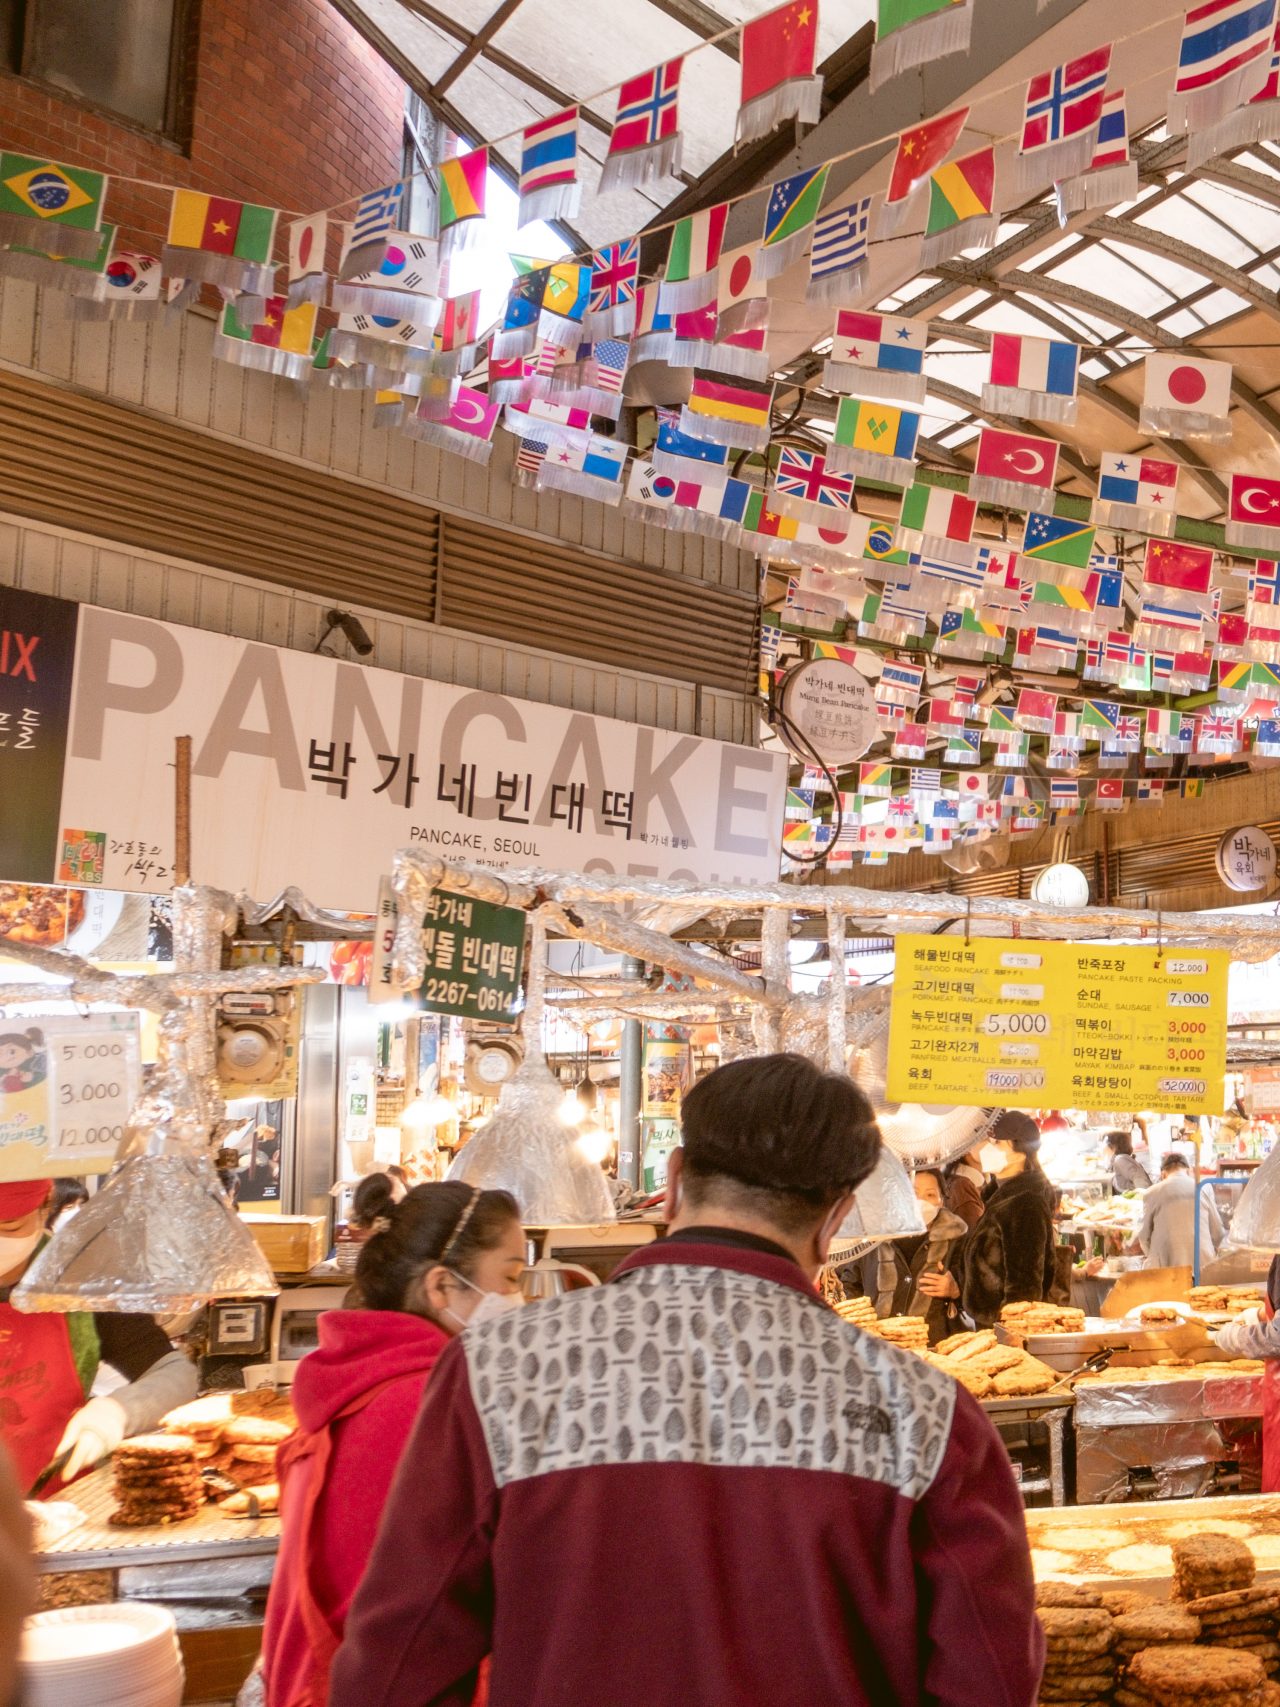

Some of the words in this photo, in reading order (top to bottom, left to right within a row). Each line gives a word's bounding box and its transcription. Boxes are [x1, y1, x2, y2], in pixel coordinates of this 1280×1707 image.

[800, 692, 820, 704] Mung
[70, 606, 771, 859] PANCAKE
[308, 738, 635, 841] 박가네빈대떡
[410, 826, 488, 853] PANCAKE,
[493, 836, 540, 858] SEOUL
[1234, 836, 1271, 862] 박가네
[1235, 861, 1254, 876] 육회
[78, 871, 103, 882] KBS
[460, 936, 517, 982] 빈대떡
[914, 949, 976, 963] 해물빈대떡
[914, 964, 951, 973] SEAFOOD
[954, 966, 989, 975] PANCAKE
[1077, 958, 1126, 972] 반죽포장
[1078, 973, 1114, 982] PANCAKE
[1119, 975, 1144, 983] PASTE
[1148, 976, 1182, 985] PACKING
[912, 980, 975, 995] 고기빈대떡
[426, 978, 514, 1014] 2267-0614
[912, 993, 955, 1002] PORKMEAT
[958, 996, 994, 1005] PANCAKE
[1077, 988, 1101, 1001] 순대
[1170, 992, 1209, 1005] 7,000
[1115, 1003, 1152, 1012] SAUSAGE
[911, 1010, 973, 1025] 녹두빈대떡
[988, 1014, 1047, 1035] 5,000
[911, 1023, 951, 1032] PANCAKE
[1075, 1018, 1112, 1031] 떡볶이
[1169, 1021, 1206, 1034] 3,000
[1077, 1031, 1133, 1040] TTEOK-BOKKI
[909, 1039, 980, 1054] 고기완자2개
[910, 1054, 948, 1063] PANFRIED
[952, 1055, 996, 1064] MEATBALLS
[1073, 1046, 1122, 1060] 마약김밥
[1167, 1048, 1206, 1062] 3,000
[1075, 1061, 1101, 1069] MAYAK
[1105, 1062, 1135, 1071] KIMBAP
[907, 1067, 932, 1080] 육회
[908, 1082, 928, 1091] BEEF
[934, 1083, 968, 1092] TARTARE
[1072, 1074, 1132, 1089] 육회탕탕이
[1073, 1090, 1091, 1098] BEEF
[1105, 1092, 1129, 1100] SMALL
[1133, 1093, 1169, 1102] OCTOPUS
[1173, 1096, 1205, 1104] TARTARE
